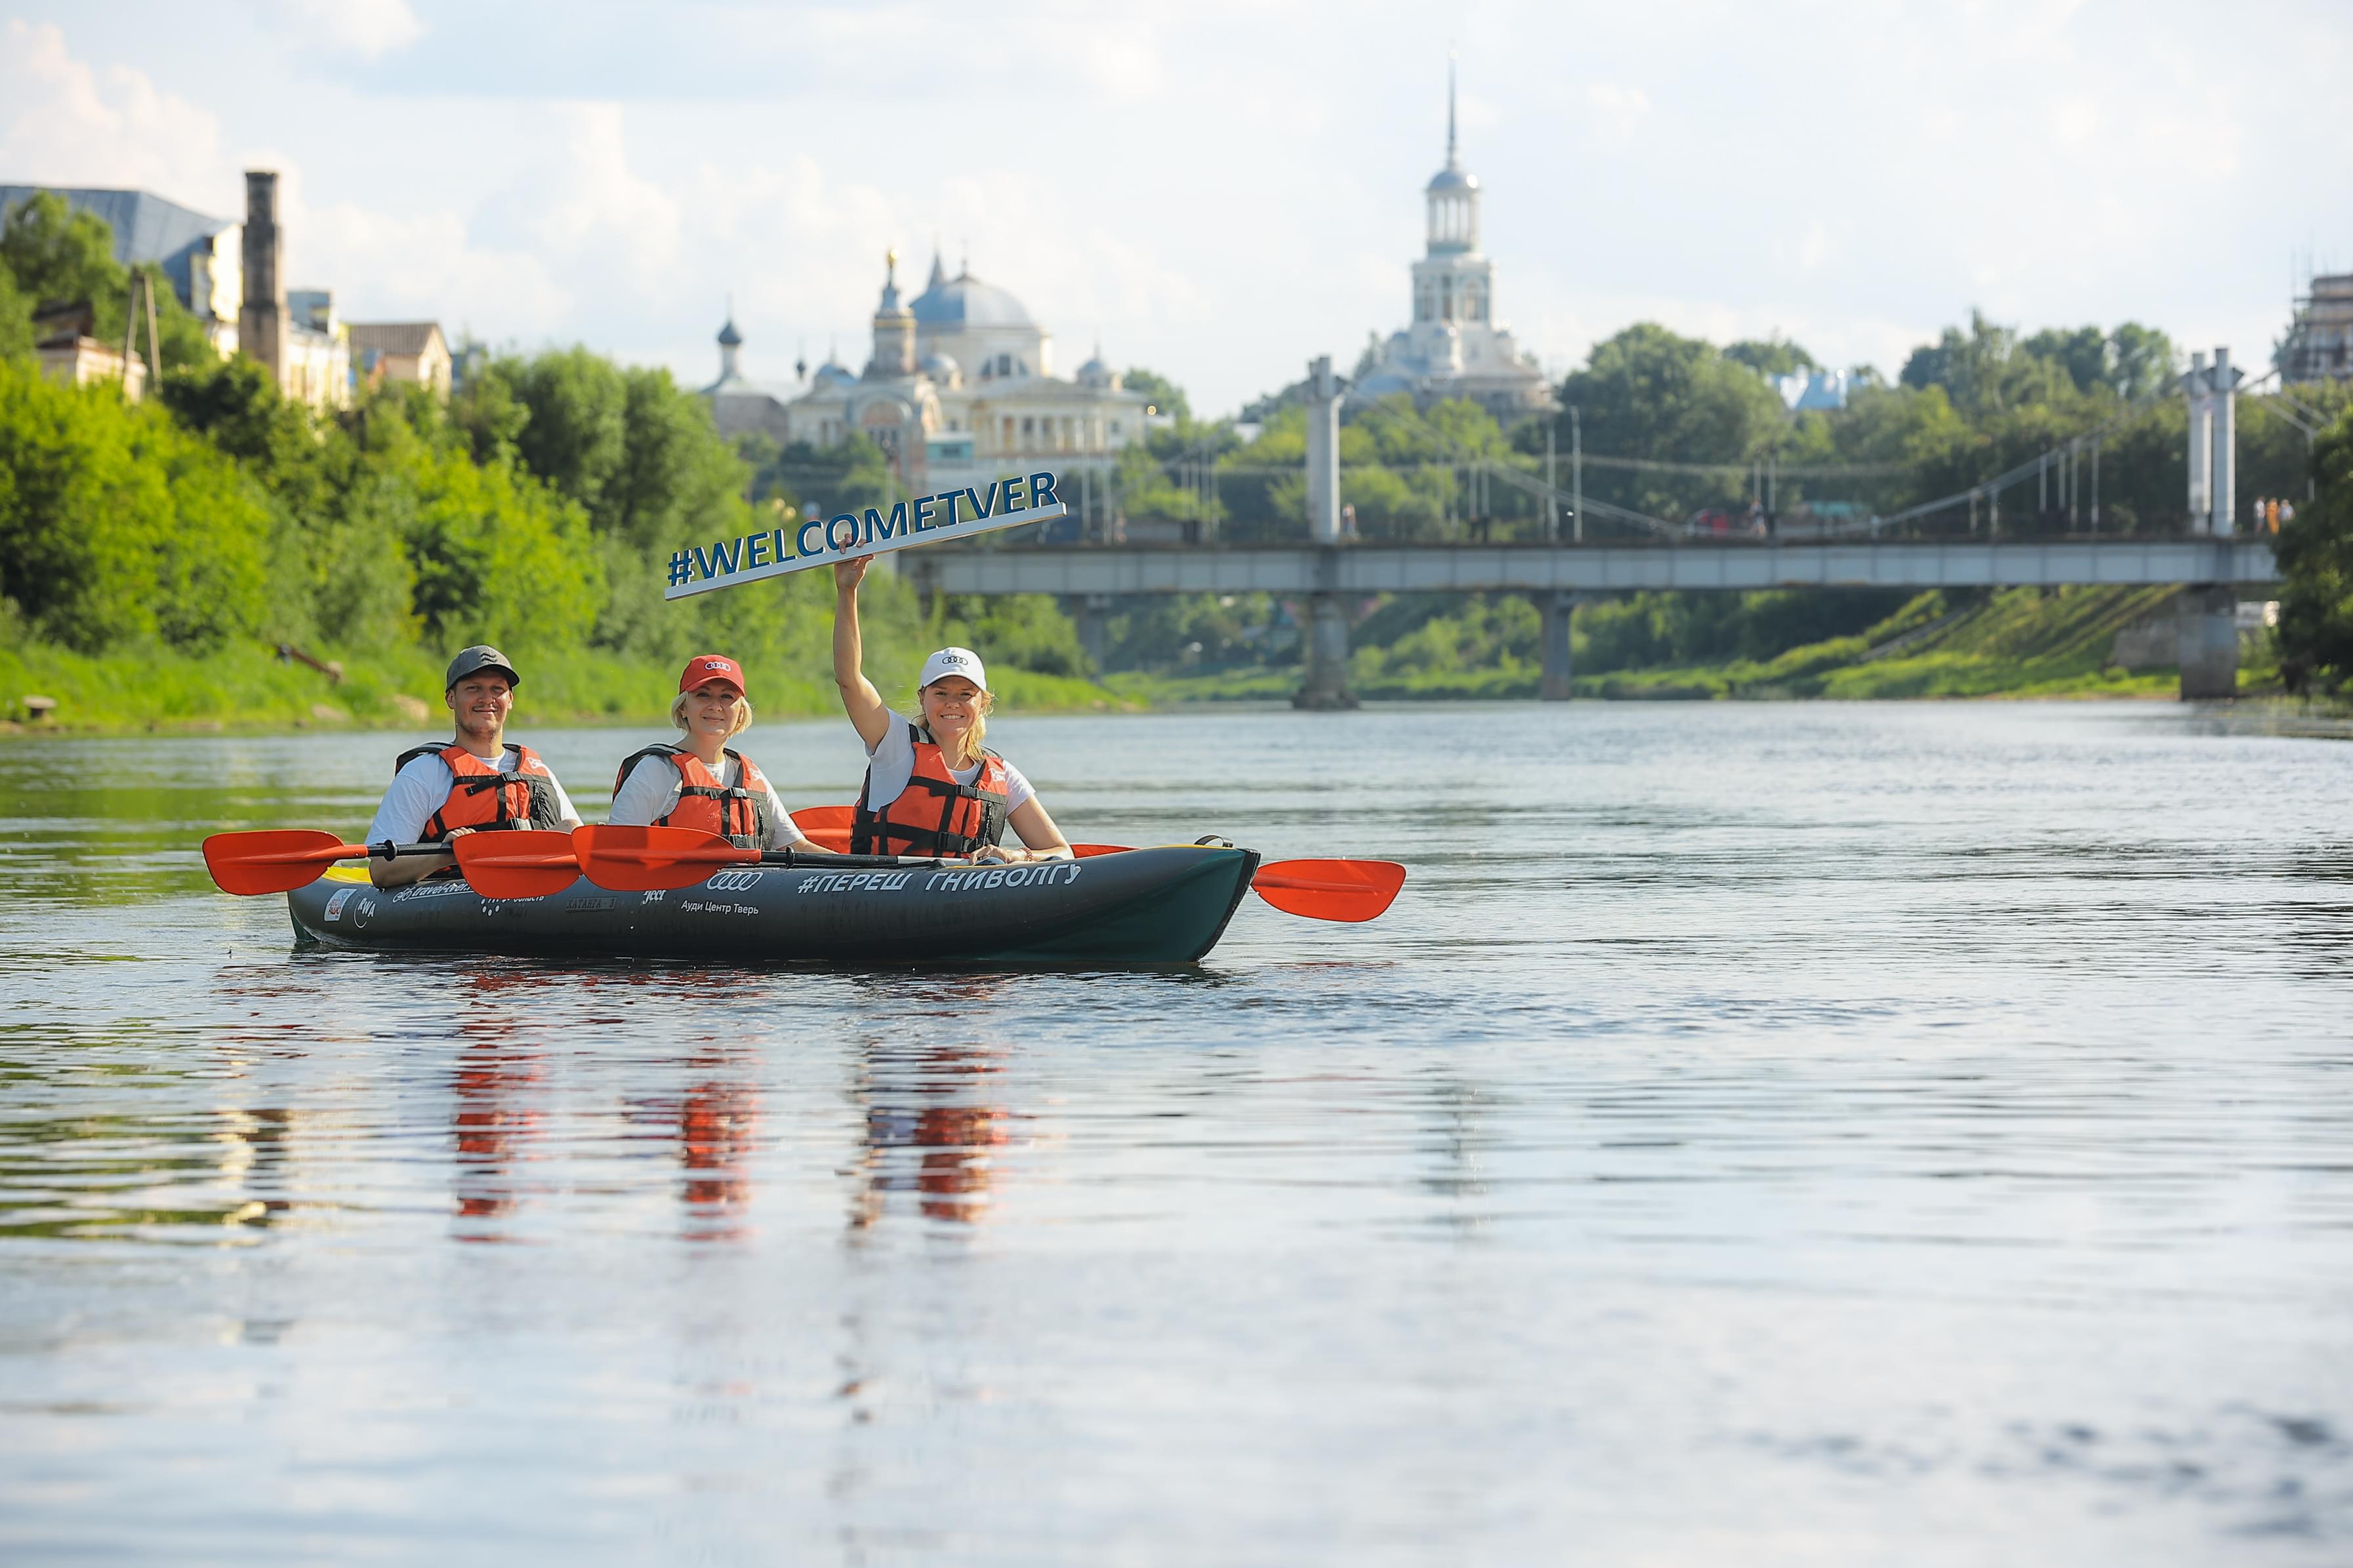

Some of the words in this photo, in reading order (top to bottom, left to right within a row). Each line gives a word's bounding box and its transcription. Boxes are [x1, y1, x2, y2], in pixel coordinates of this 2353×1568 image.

[668, 471, 1061, 587] #WELCOMETVER
[358, 898, 376, 917] RWA
[681, 900, 703, 912] Ауди
[705, 902, 731, 914] Центр
[733, 904, 759, 916] Тверь
